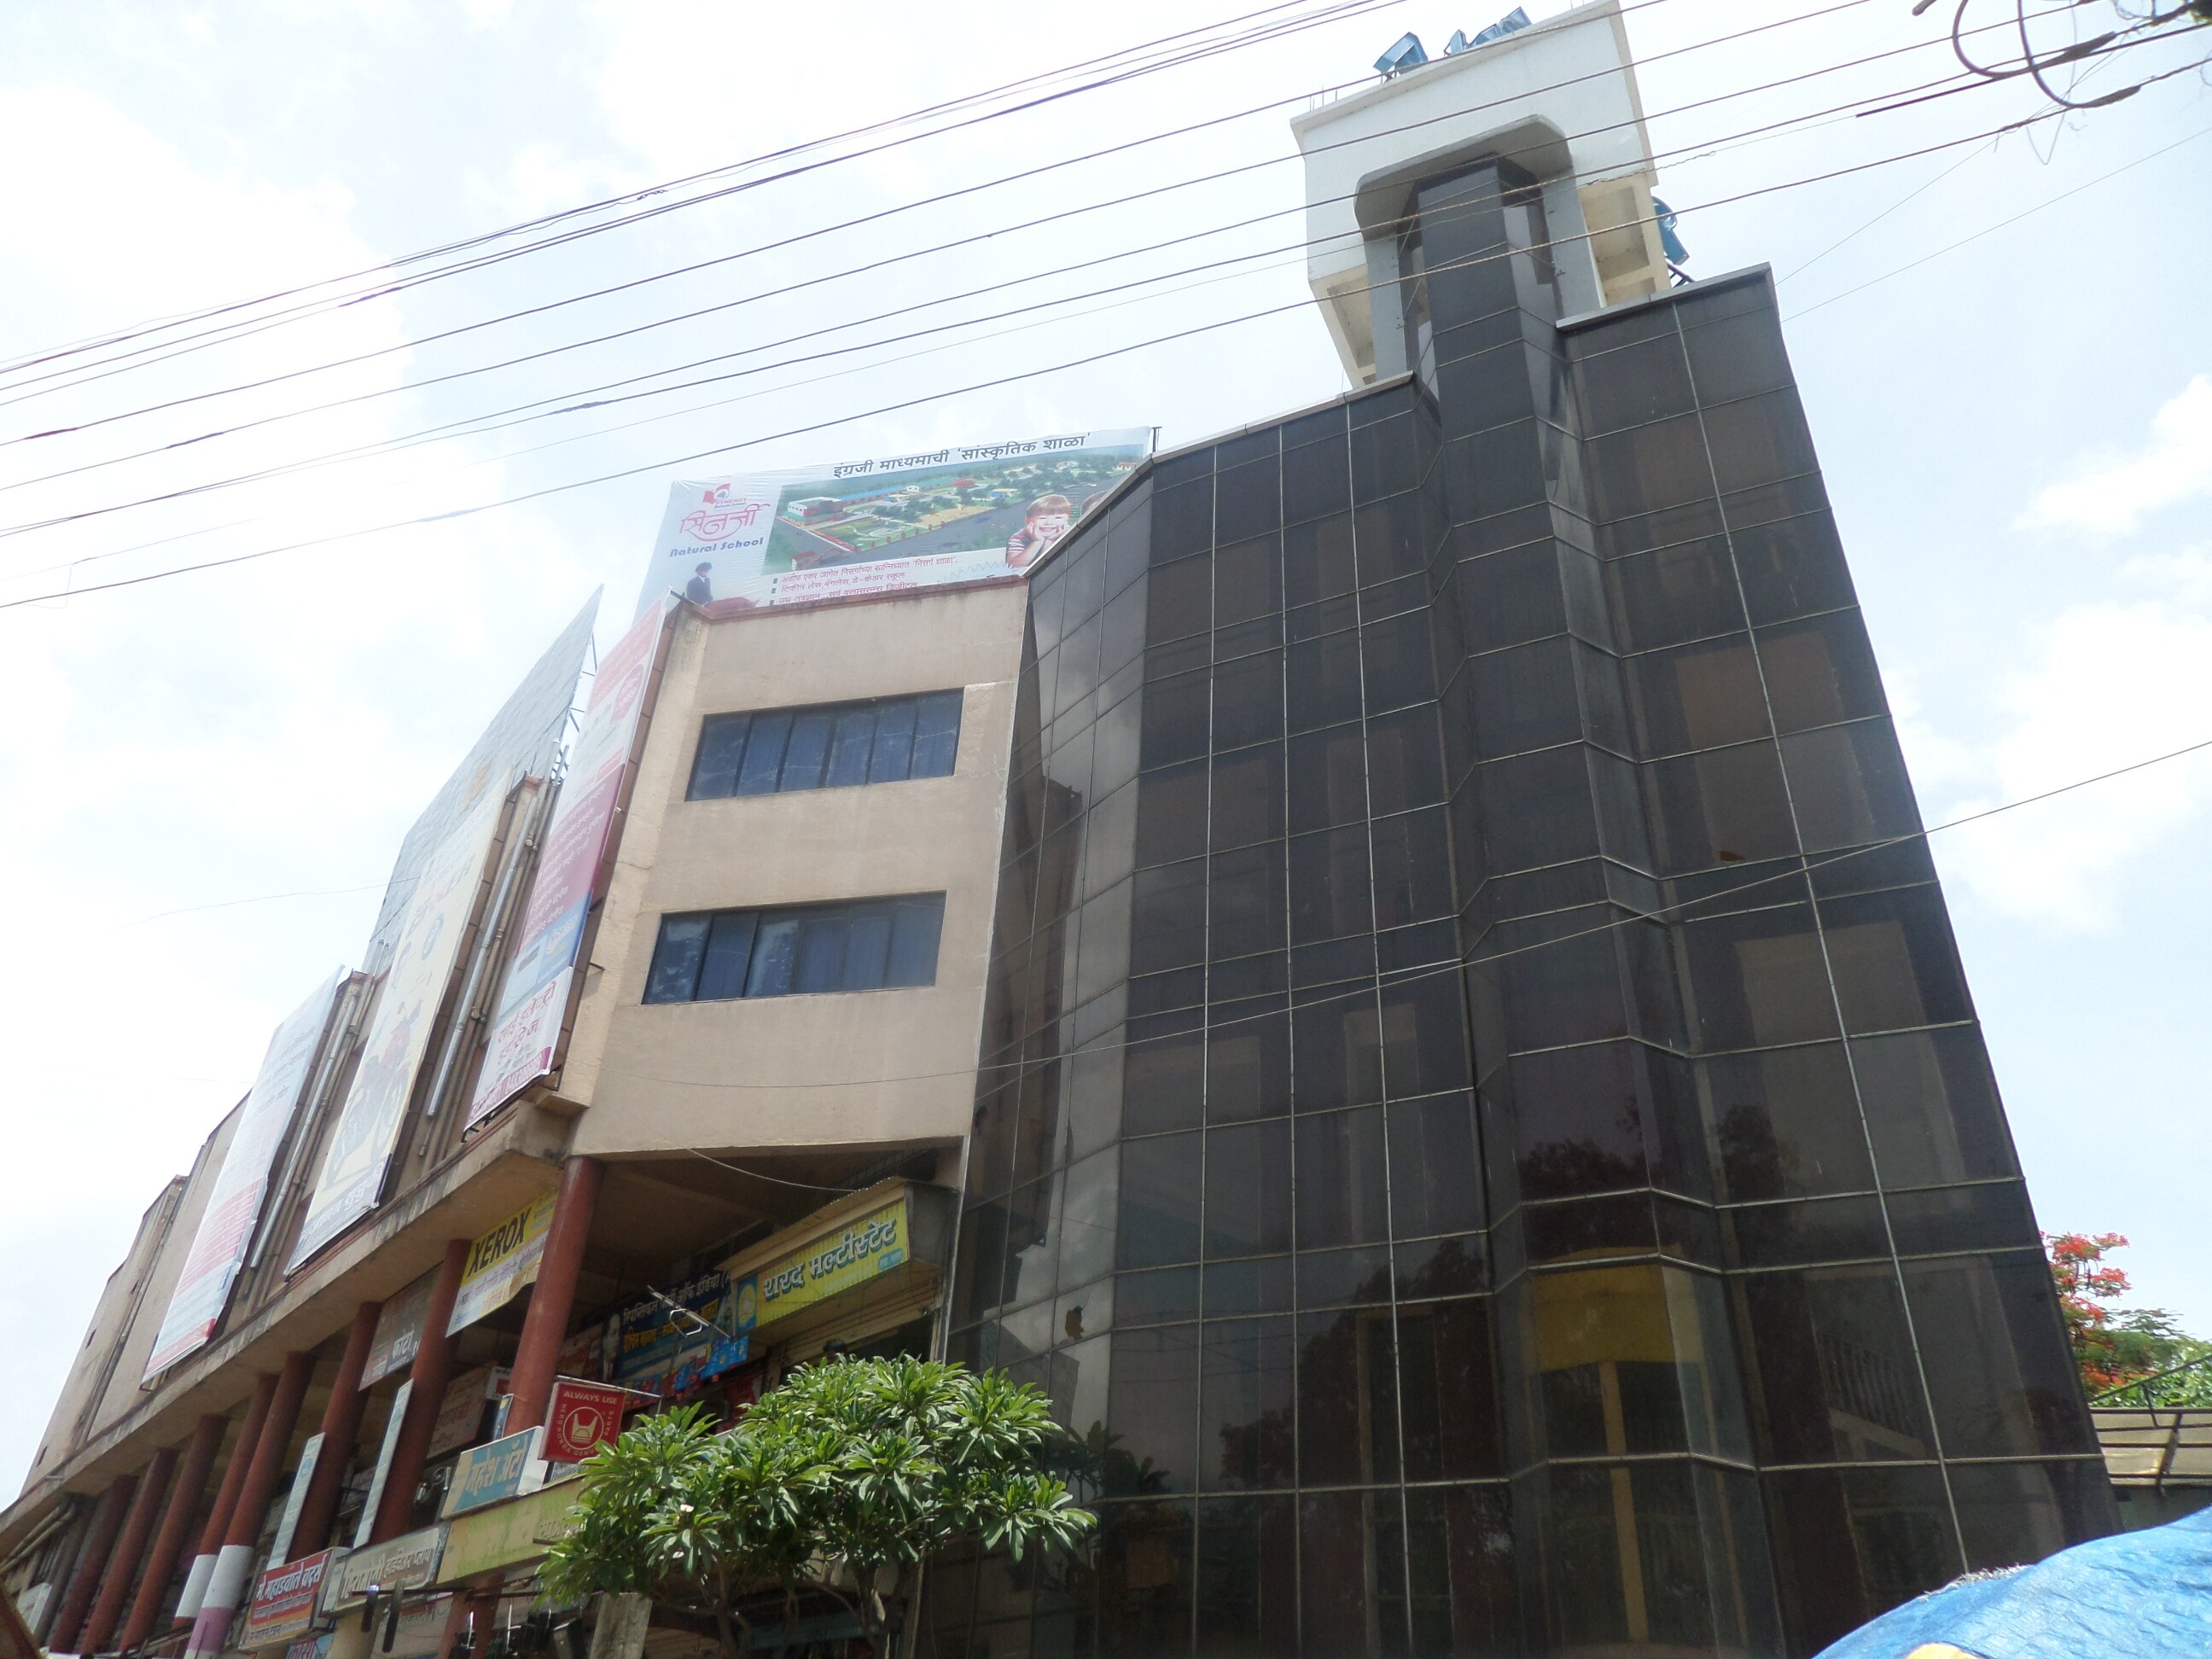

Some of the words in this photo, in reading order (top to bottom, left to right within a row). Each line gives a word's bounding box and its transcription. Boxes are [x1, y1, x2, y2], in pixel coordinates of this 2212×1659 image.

[833, 459, 873, 479] इंग्रजी
[879, 450, 949, 471] माध्यमाची
[720, 537, 764, 550] School
[467, 1206, 533, 1278] XEROX
[763, 1262, 806, 1302] शरद
[808, 1218, 898, 1280] मल्टीस्टेट
[563, 1391, 599, 1402] ALWAYS
[602, 1396, 619, 1405] USE
[557, 1403, 568, 1425] HERO
[556, 1426, 571, 1453] HONDA
